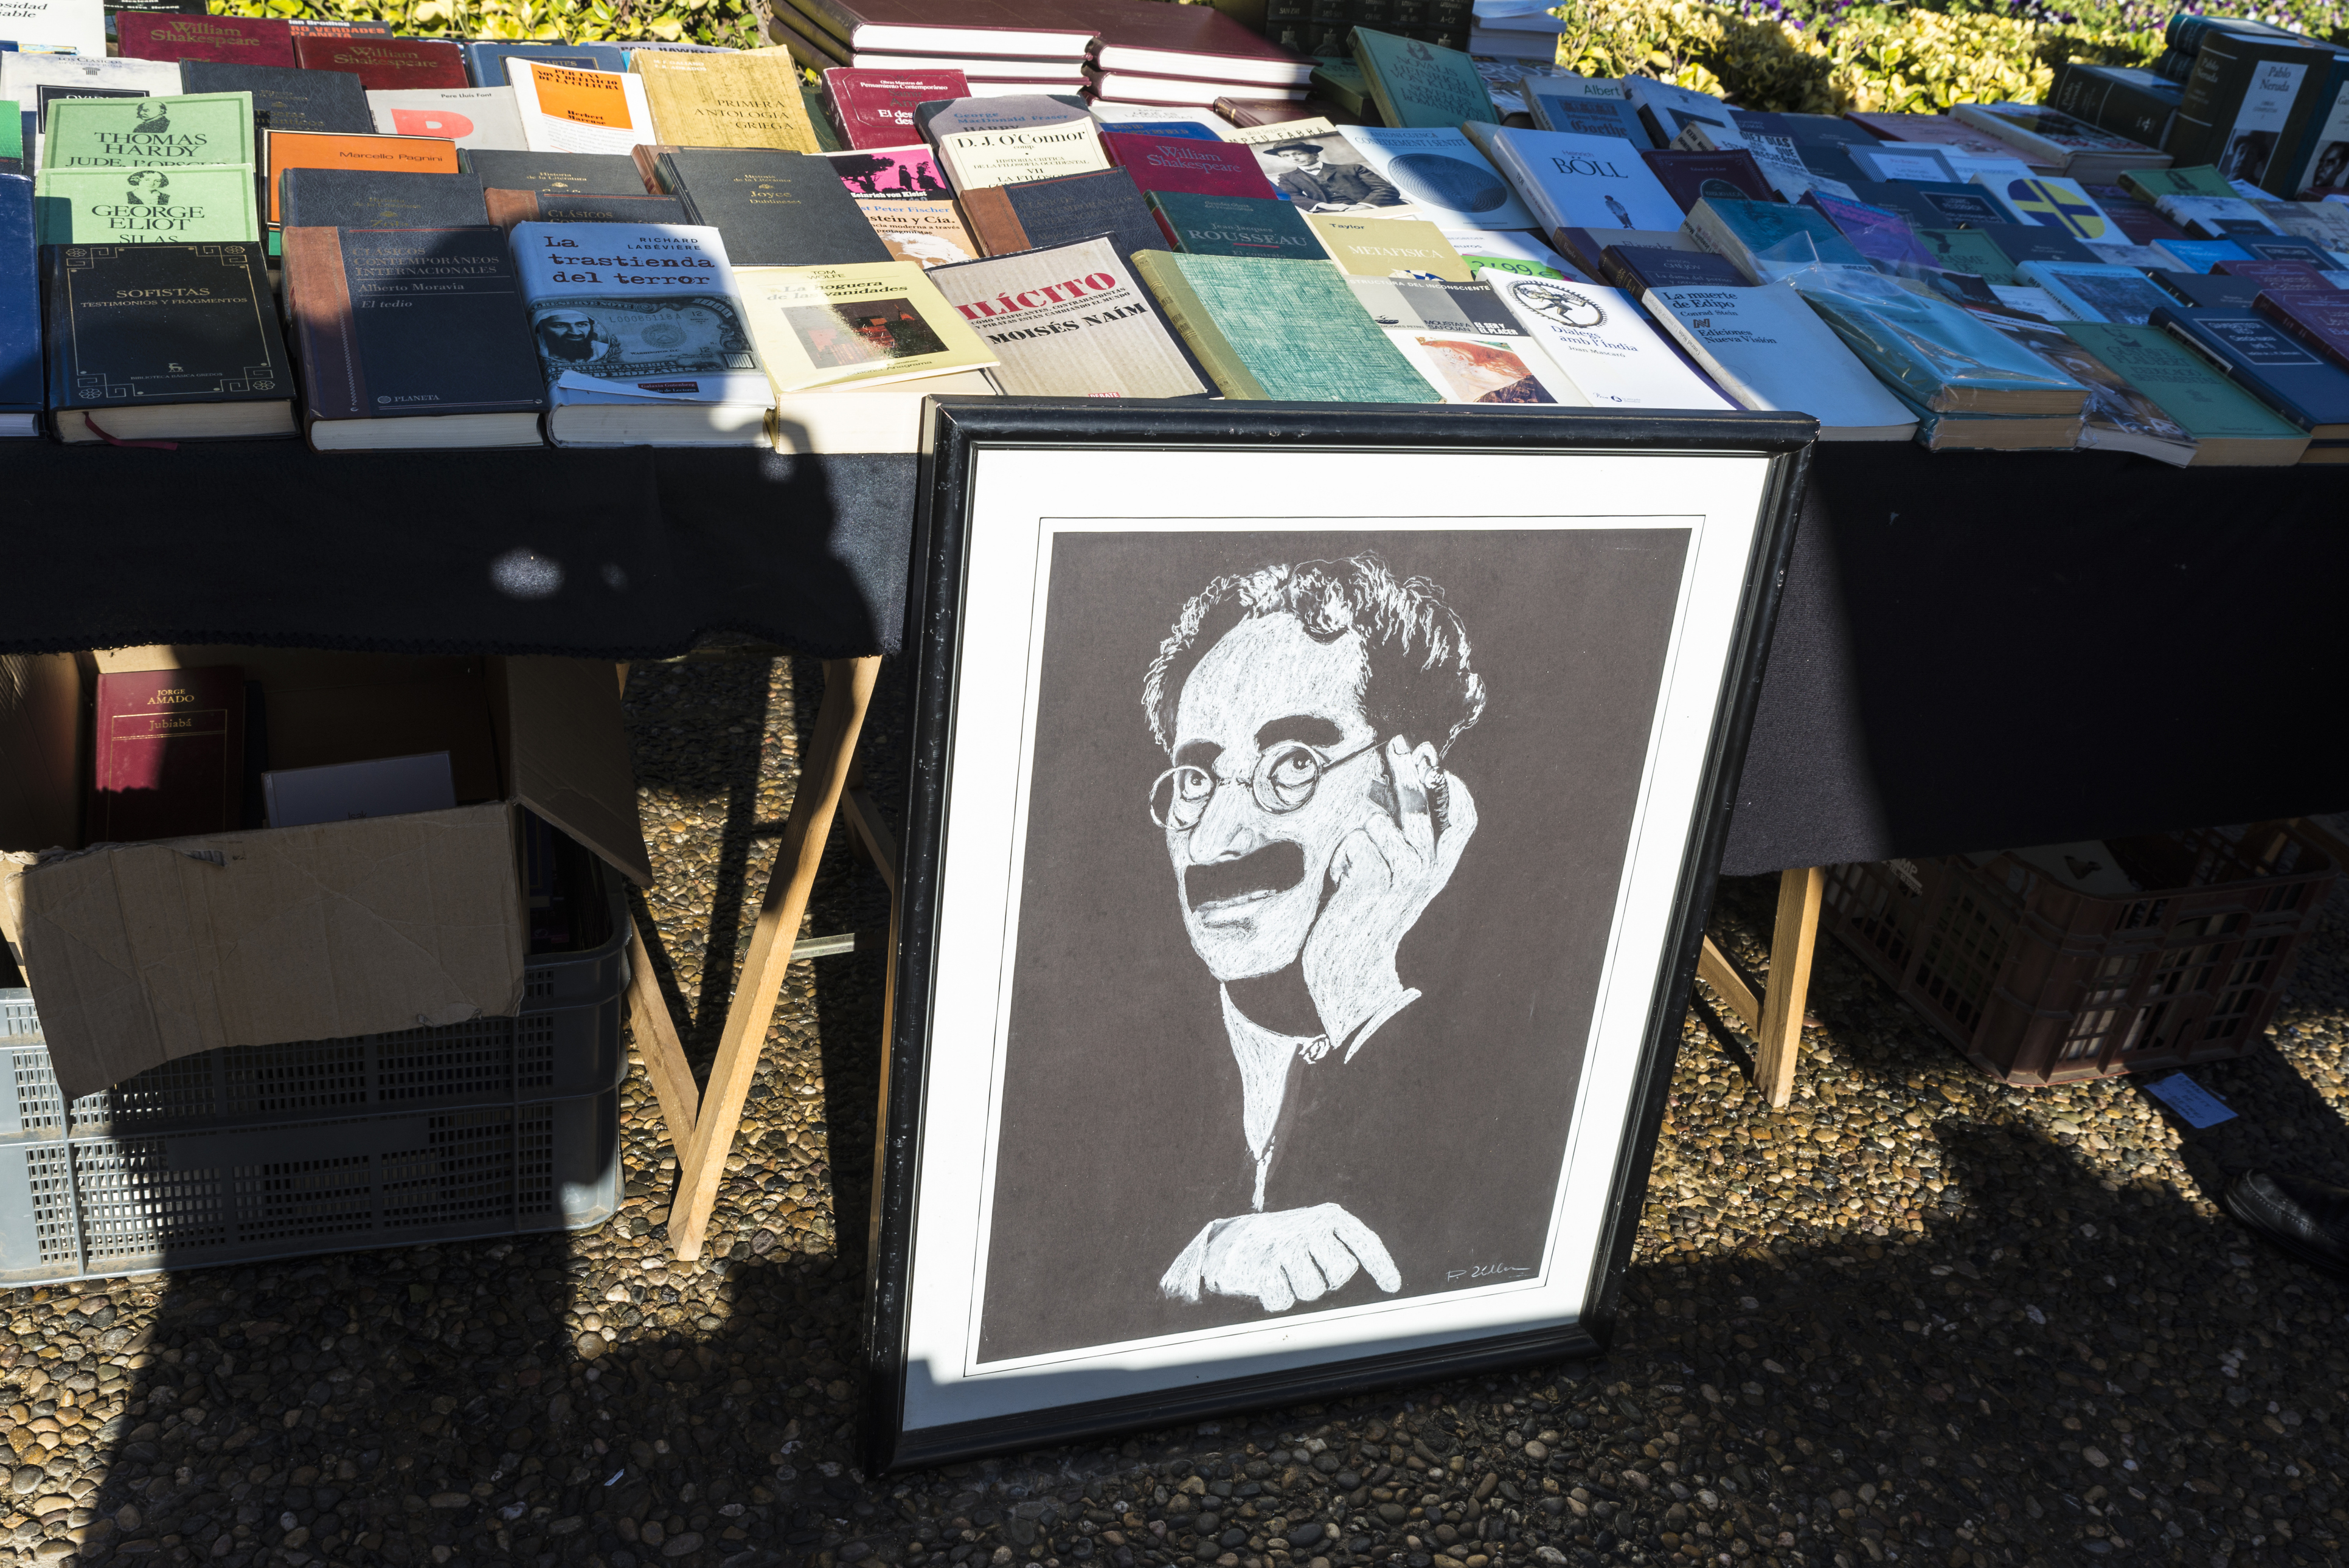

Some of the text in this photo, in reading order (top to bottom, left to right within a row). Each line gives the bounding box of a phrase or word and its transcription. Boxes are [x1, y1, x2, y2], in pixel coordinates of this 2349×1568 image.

[169, 21, 242, 36] William
[314, 26, 386, 35] VERDADES
[151, 30, 260, 47] Shakespeare
[350, 46, 419, 60] William
[334, 54, 438, 69] Shakespeare
[1395, 55, 1459, 77] NOVALIS
[536, 70, 561, 79] NOVA
[1393, 63, 1469, 89] HEINRICH
[2269, 66, 2291, 78] Pablo
[571, 81, 619, 91] CULTURA
[900, 83, 948, 91] Contemporáneo
[1390, 69, 1477, 99] VON KLEIST
[2259, 79, 2290, 92] Neruda
[888, 88, 922, 99] Samir
[1584, 84, 1621, 96] Albert
[717, 99, 785, 108] PRIMERA
[567, 109, 604, 120] Herbert
[878, 109, 893, 118] El
[567, 114, 606, 125] Marcuse
[957, 116, 1027, 125] MacDonald
[735, 121, 794, 130] GRIEGA
[1570, 120, 1628, 137] Goethe
[94, 131, 207, 145] THOMAS
[1277, 126, 1326, 140] FABRA
[1370, 130, 1400, 139] ANTONI
[956, 130, 1085, 149] D. J. O'Connor
[1355, 136, 1467, 148] CONEIXEMENT SENTIT
[1740, 131, 1791, 148] DIEZ DIAS
[103, 144, 201, 158] HARDY
[339, 151, 443, 162] Marcello Pagnini
[1155, 145, 1223, 162] William
[65, 157, 127, 167] JUDE,
[1147, 153, 1242, 174] Shakespeare
[1549, 156, 1629, 179] BÖLL
[91, 204, 206, 218] GEORGE
[547, 209, 614, 220] CLÁSICOS
[108, 217, 191, 231] ELIOT
[924, 215, 956, 224] Cía.
[1210, 223, 1274, 233] Jean-Jacques
[119, 234, 179, 243] SILAS
[543, 235, 579, 249] La
[1186, 229, 1308, 246] ROUSSEAU
[352, 246, 426, 257] CLÁSICOS
[1347, 245, 1446, 259] METAFISICA
[354, 255, 500, 266] CONTEMPORÁNEOS
[547, 253, 715, 268] trastienda
[355, 265, 498, 276] INTERNACIONALES
[552, 271, 710, 285] del terror
[359, 282, 465, 293] Alberto Moravia
[815, 281, 883, 291] hoguera
[1345, 278, 1404, 287] ESTRUCTURA
[1426, 283, 1491, 292] INCONSCIENTE
[116, 287, 211, 299] SOFISTAS
[824, 286, 908, 297] vanidades
[954, 271, 1116, 321] ILÍCITO
[1662, 291, 1738, 300] La muerte
[80, 299, 158, 308] TESTIMONIOS
[380, 299, 413, 308] tedio
[993, 307, 1052, 325] TRAFICANTES,
[1052, 286, 1126, 310] CONTRABANDISTAS
[1673, 299, 1736, 309] de Edipo
[982, 318, 1018, 329] PIRATAS
[1018, 313, 1044, 323] ESTÁN
[1045, 302, 1091, 317] CAMBIANDO
[1103, 291, 1131, 304] MUNDO
[986, 302, 1148, 345] MOISÉS NAÍM
[1424, 320, 1473, 328] MOUSTAFA
[1427, 324, 1519, 336] SAFOUAN PLACER
[1550, 325, 1601, 339] Diàlegs
[1559, 335, 1591, 345] amb
[1741, 335, 1778, 344] Visión
[1589, 349, 1626, 358] Mascaró
[723, 352, 755, 369] 1000
[886, 361, 933, 370] Anagrama
[394, 394, 440, 403] PLANETA
[157, 689, 186, 697] JORGE
[147, 695, 195, 705] AMADO
[148, 718, 192, 731] Jubiabá
[348, 811, 367, 820] Isak
